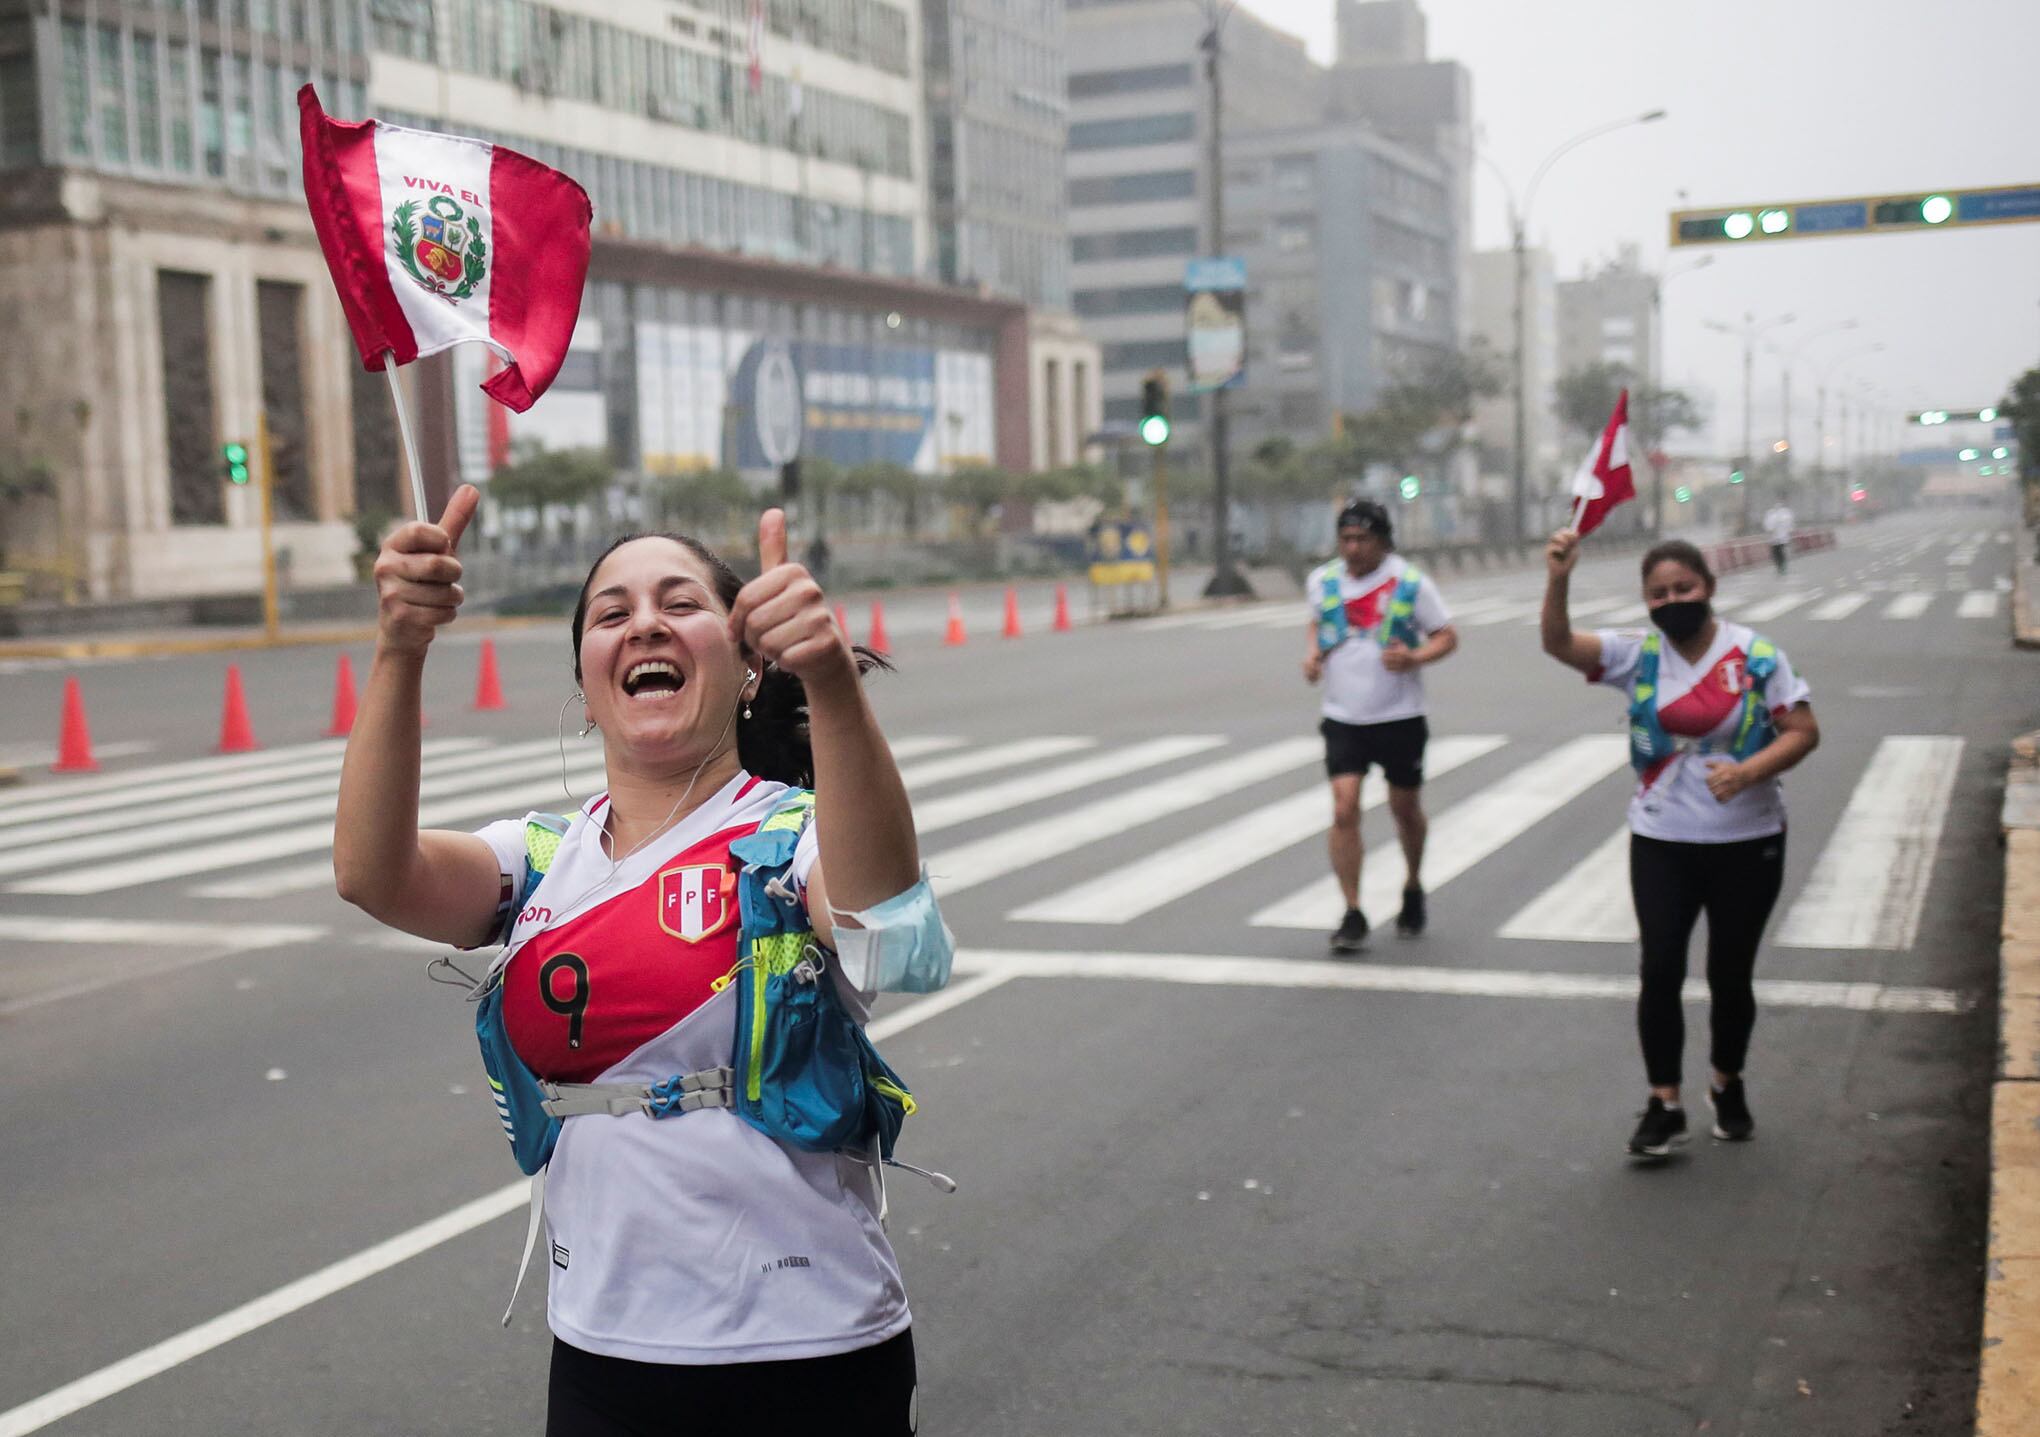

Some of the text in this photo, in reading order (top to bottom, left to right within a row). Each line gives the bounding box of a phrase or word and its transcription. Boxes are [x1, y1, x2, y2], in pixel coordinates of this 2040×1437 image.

[403, 175, 484, 209] VIVA EL
[538, 951, 590, 1050] 9
